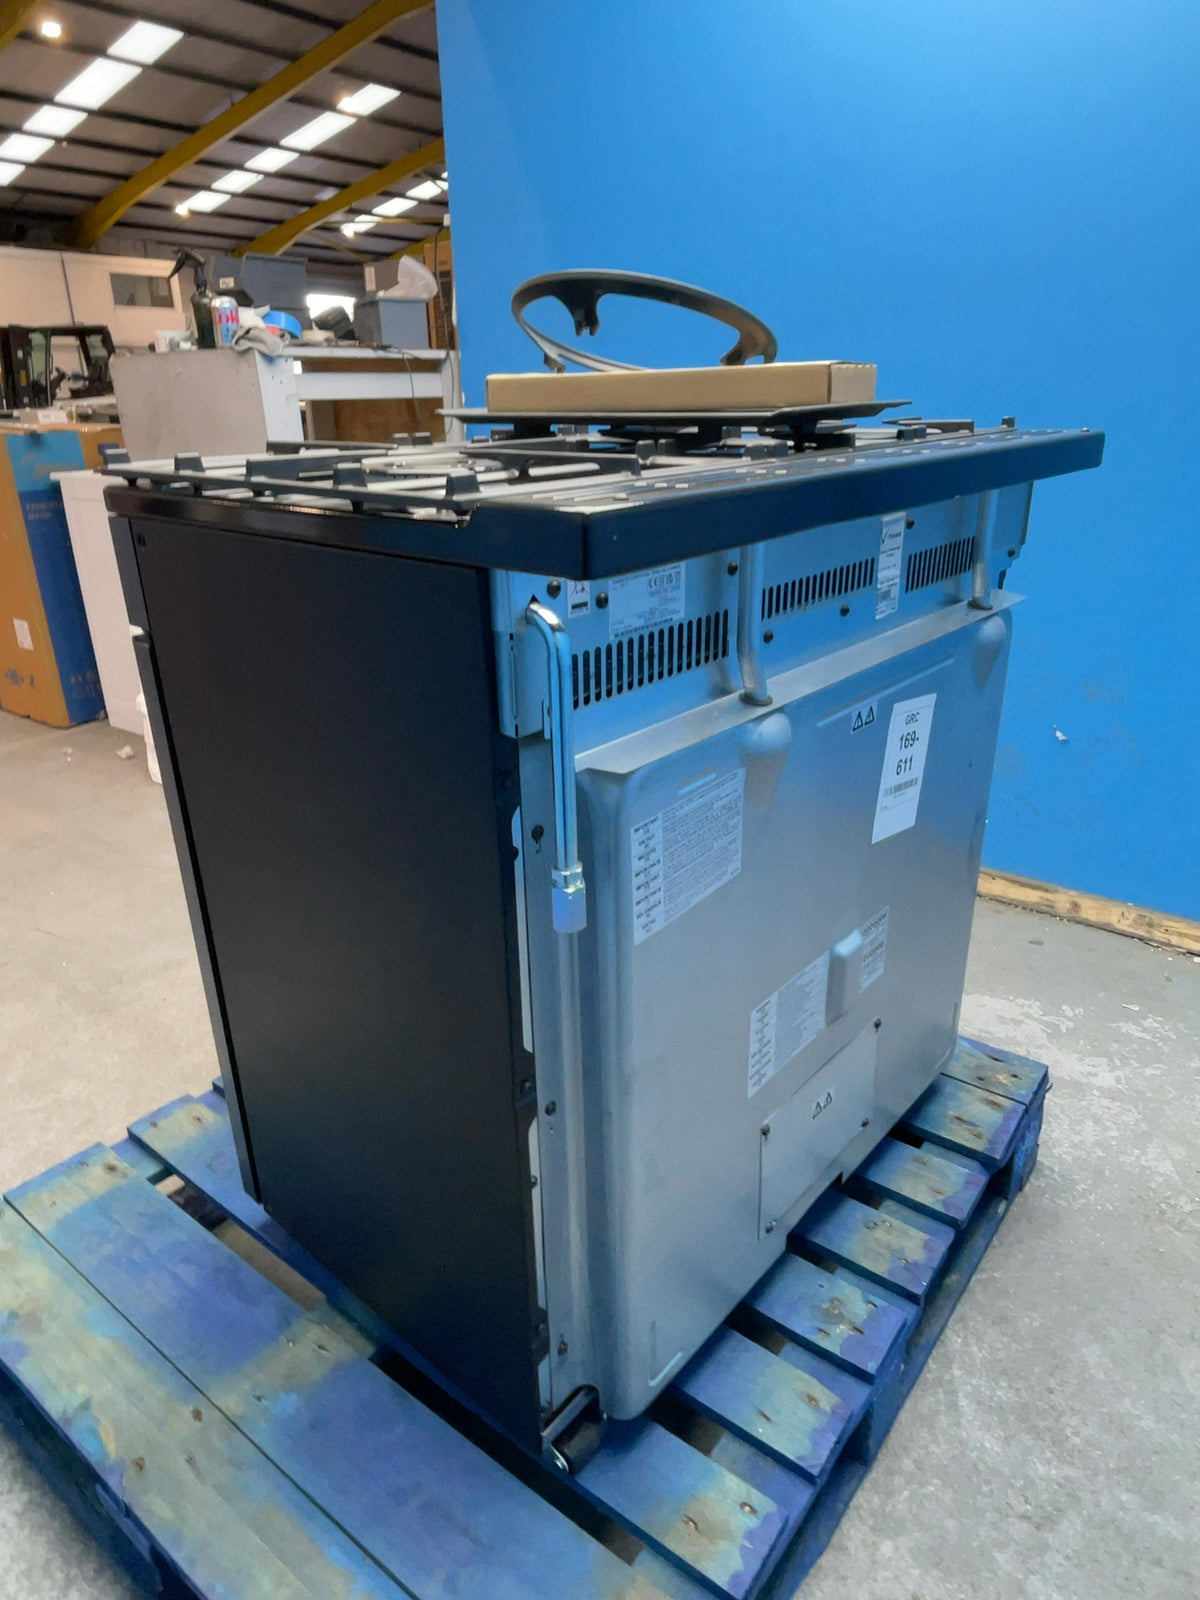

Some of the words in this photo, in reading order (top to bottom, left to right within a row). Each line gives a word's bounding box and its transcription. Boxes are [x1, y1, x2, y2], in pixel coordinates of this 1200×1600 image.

[905, 712, 920, 725] GRC
[900, 730, 919, 751] 169-
[896, 755, 913, 775] 611
